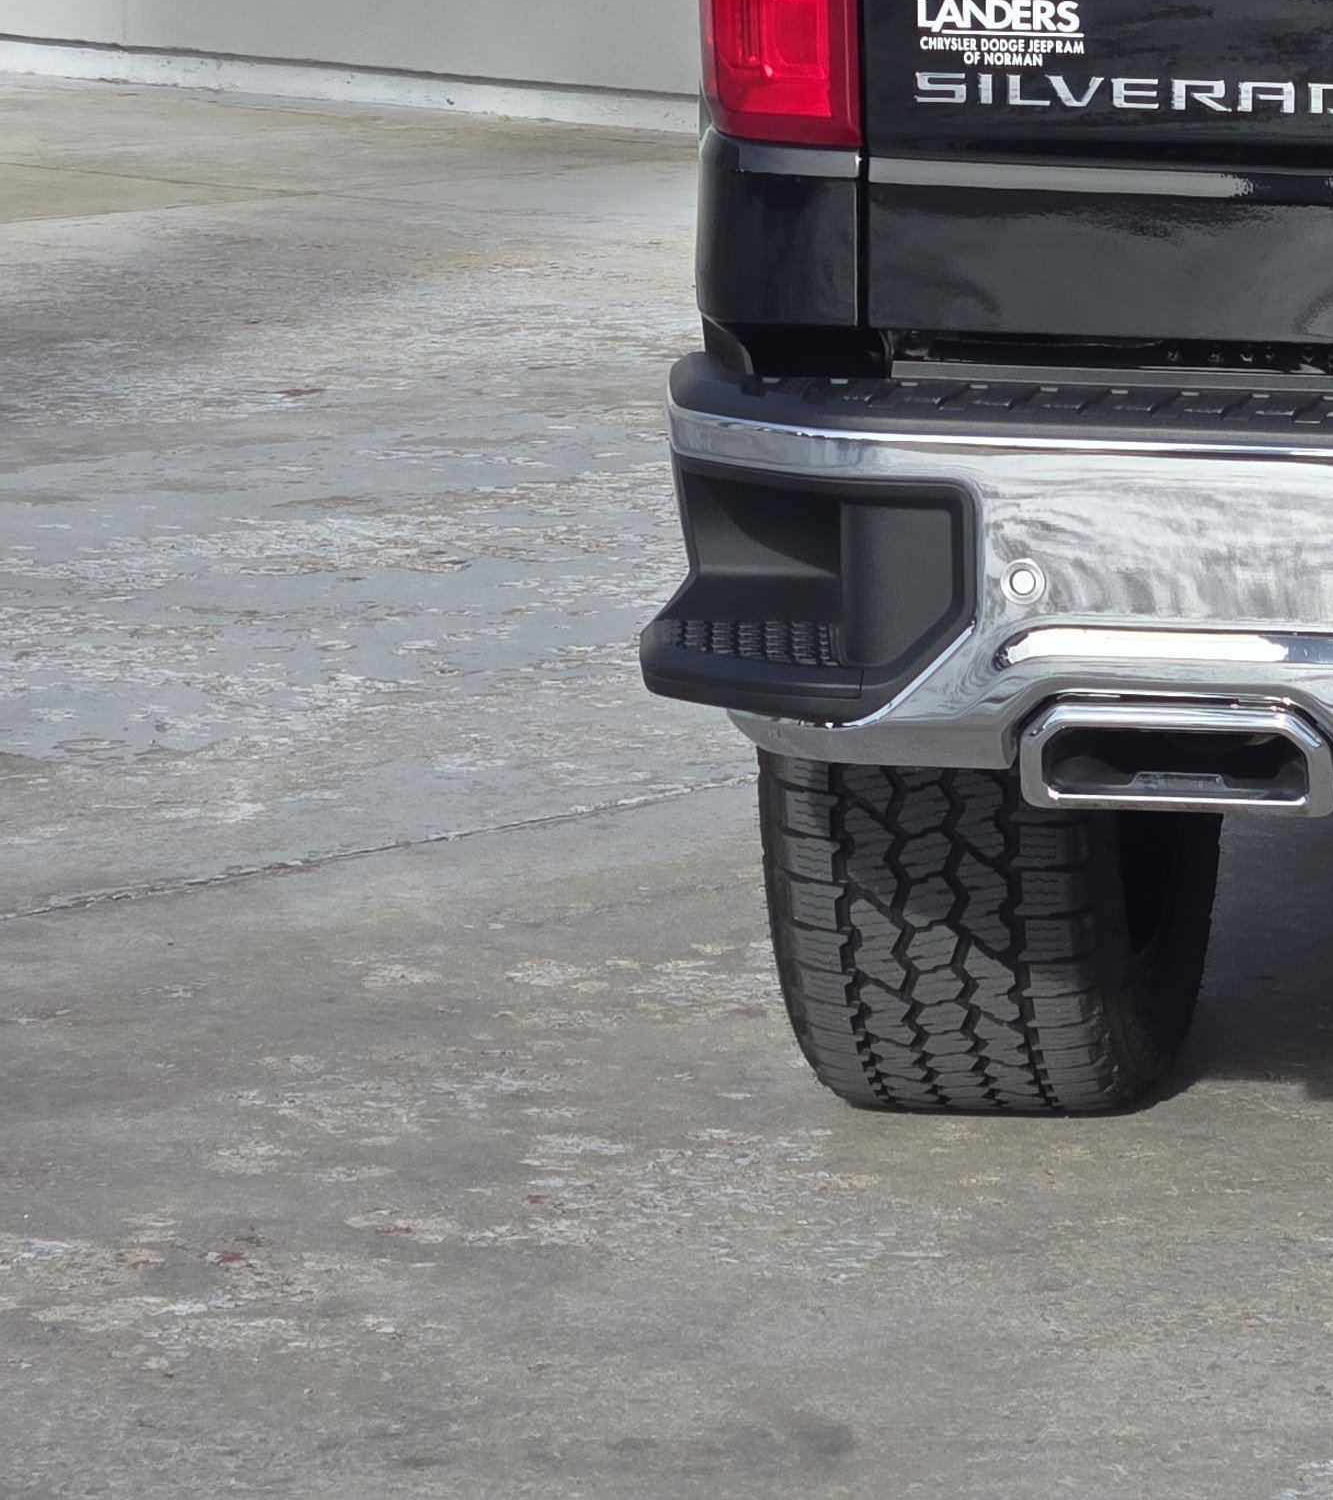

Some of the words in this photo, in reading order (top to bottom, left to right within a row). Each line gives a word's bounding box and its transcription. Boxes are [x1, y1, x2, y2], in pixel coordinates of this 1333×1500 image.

[920, 36, 978, 52] CHRYSLER
[980, 38, 1025, 53] DODGE
[1027, 39, 1055, 53] JEEP
[1055, 40, 1085, 55] RAM
[963, 51, 981, 66] OF
[983, 52, 1043, 67] NORMAN
